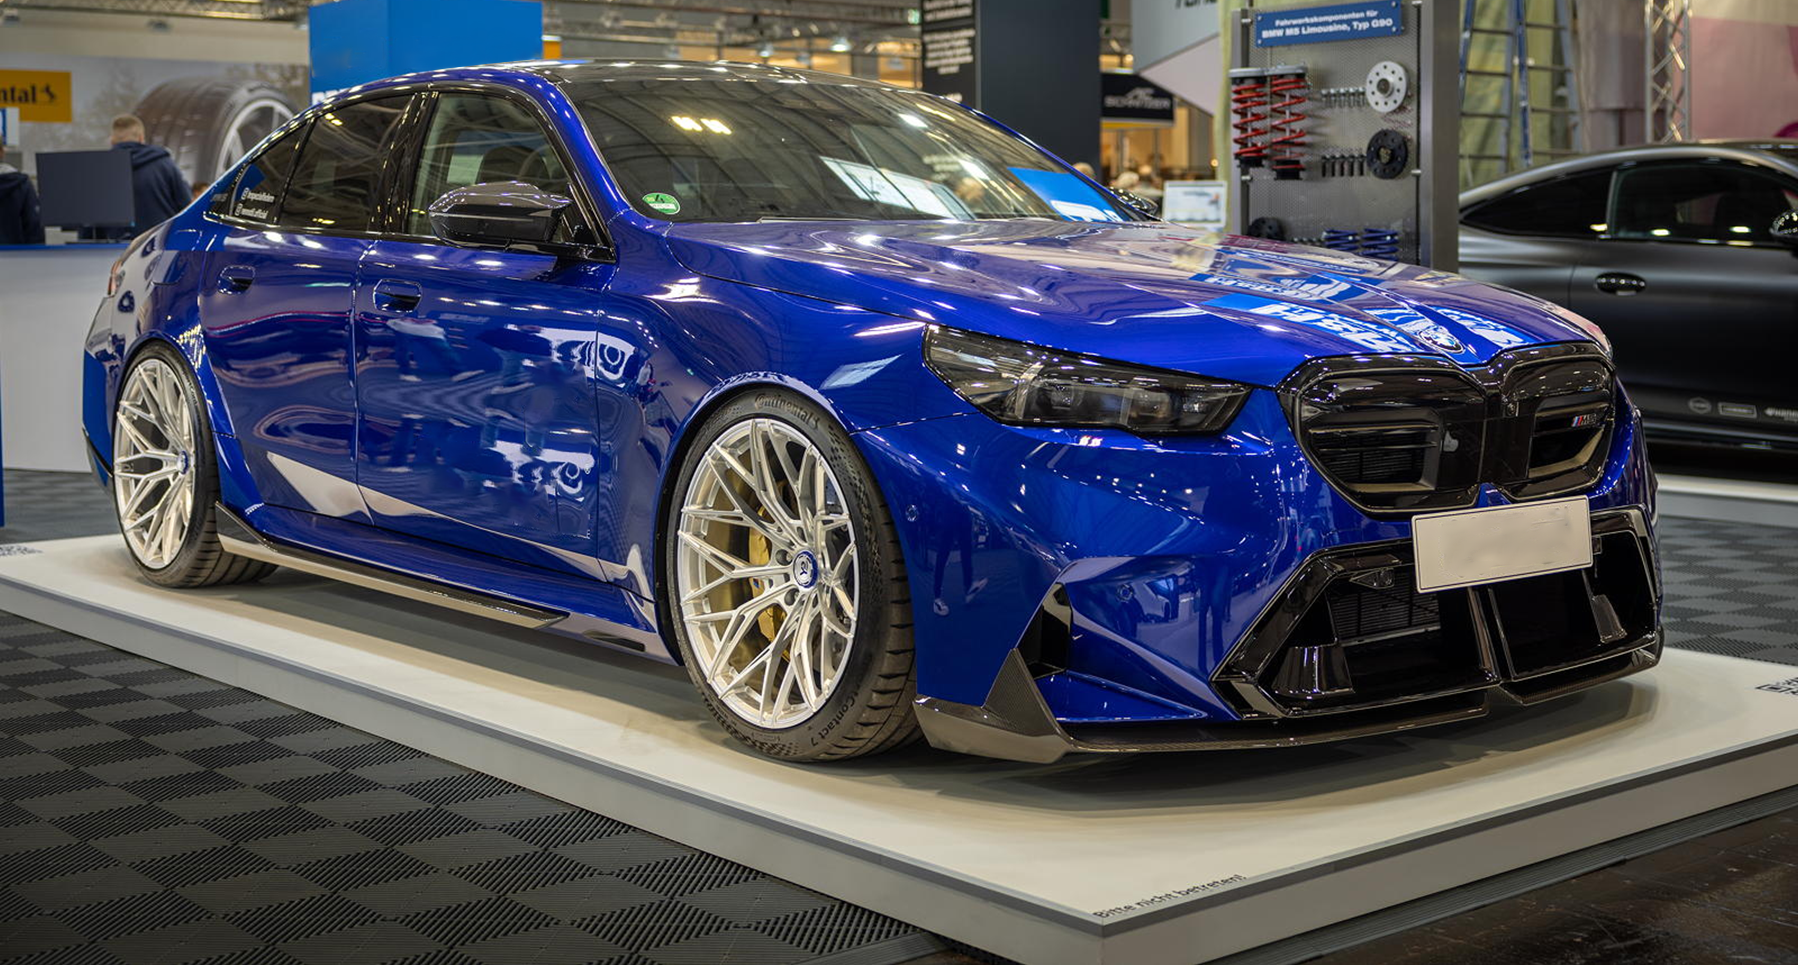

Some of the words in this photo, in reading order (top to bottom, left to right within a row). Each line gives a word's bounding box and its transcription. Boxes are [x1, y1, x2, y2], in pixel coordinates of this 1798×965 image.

[1366, 9, 1379, 17] für
[1262, 28, 1285, 38] BMW
[1352, 20, 1370, 31] Typ
[754, 393, 814, 424] Continental
[1093, 903, 1133, 919] Bitte
[1136, 892, 1174, 908] nicht
[1172, 873, 1248, 897] betreten!
